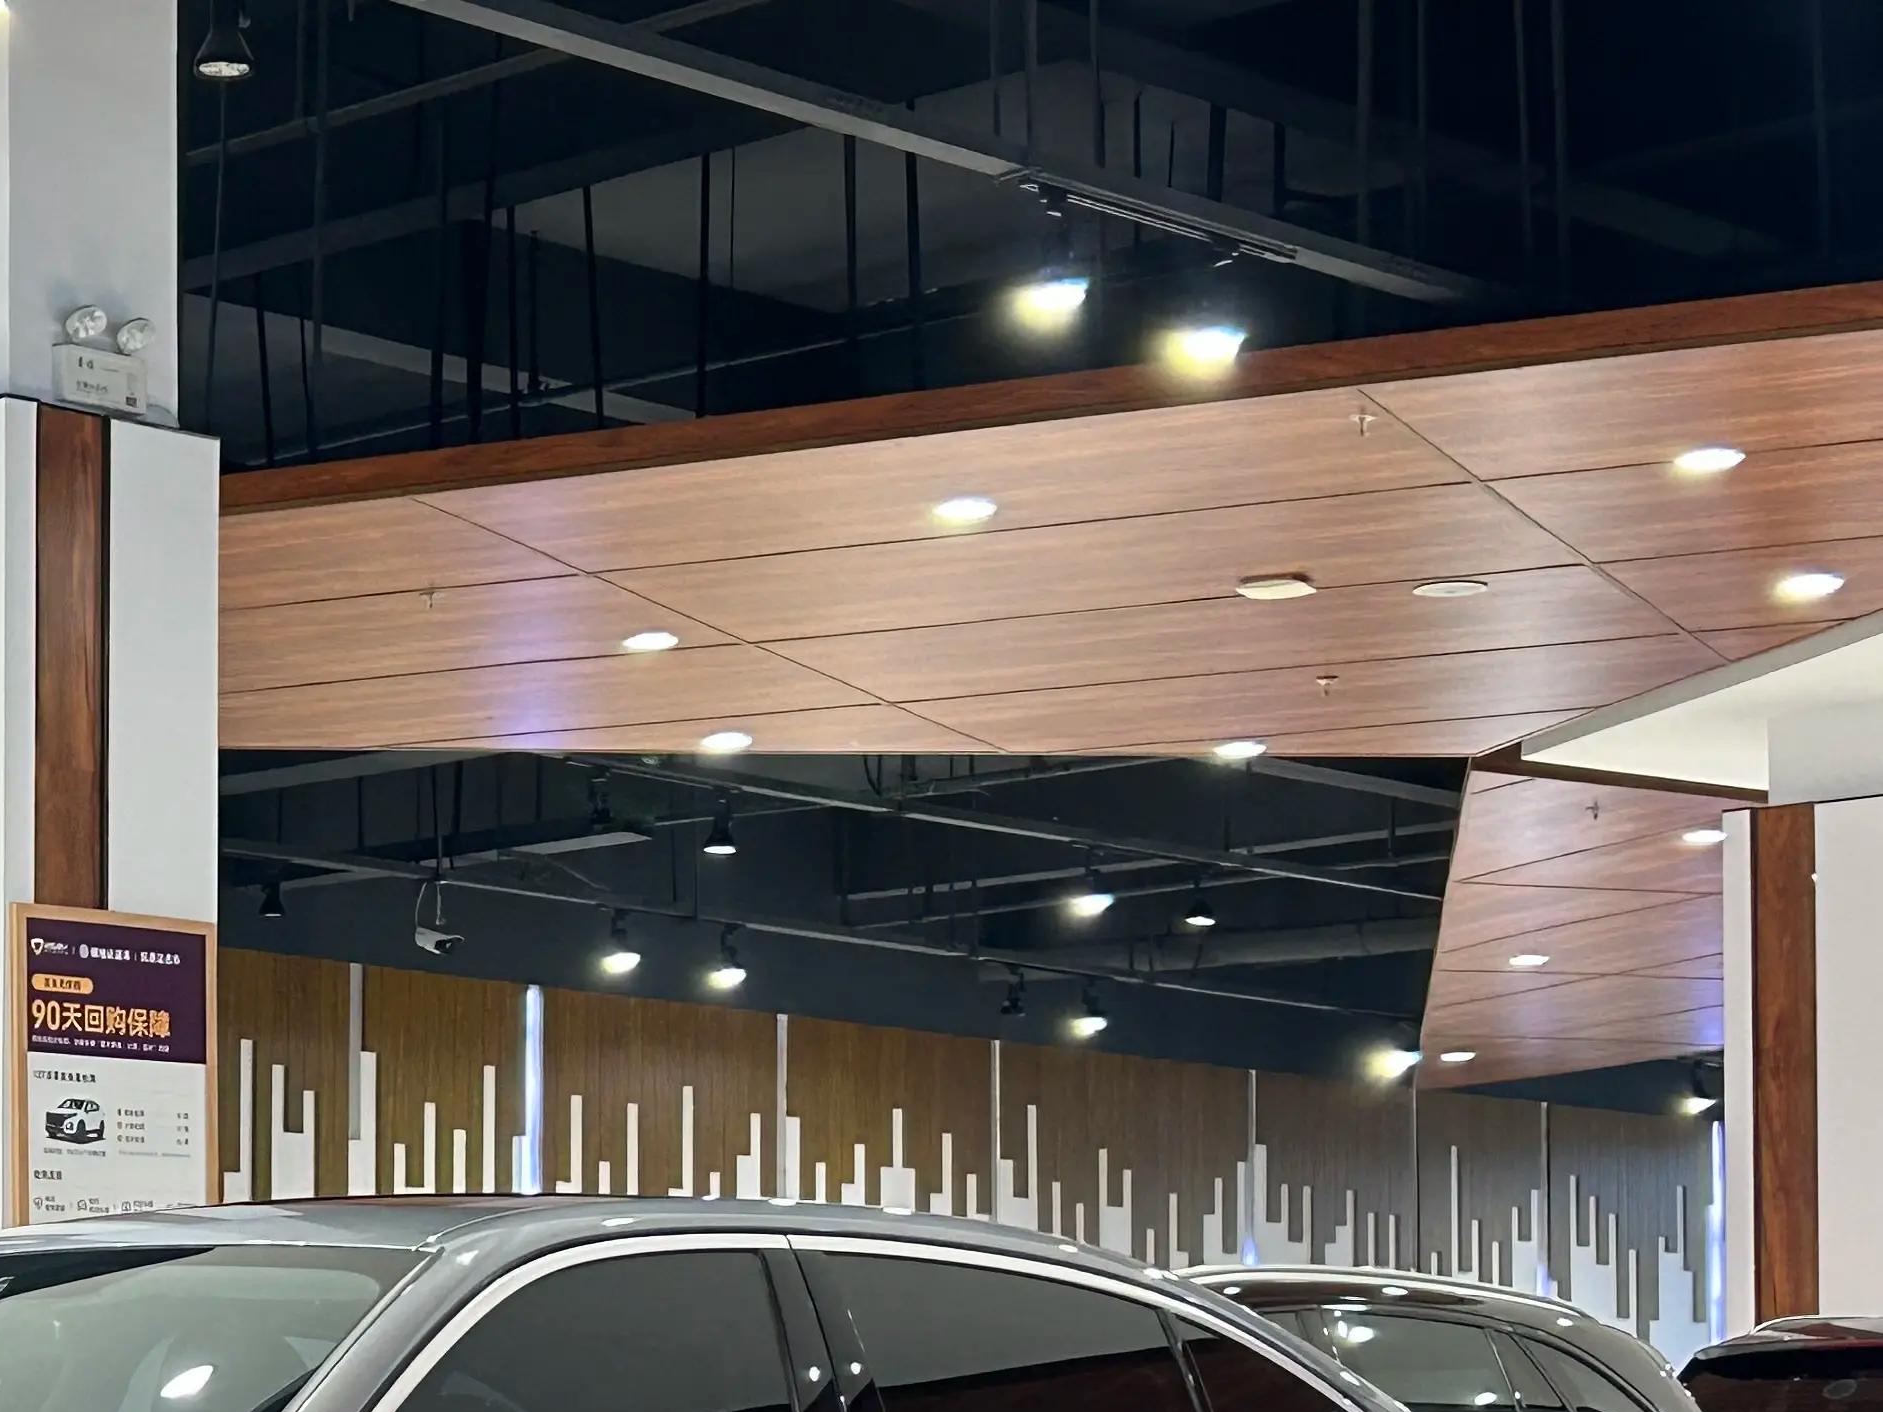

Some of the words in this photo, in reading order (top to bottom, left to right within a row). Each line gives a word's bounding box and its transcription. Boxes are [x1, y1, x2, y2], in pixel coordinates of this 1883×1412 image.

[31, 999, 171, 1038] 90天回购保障
